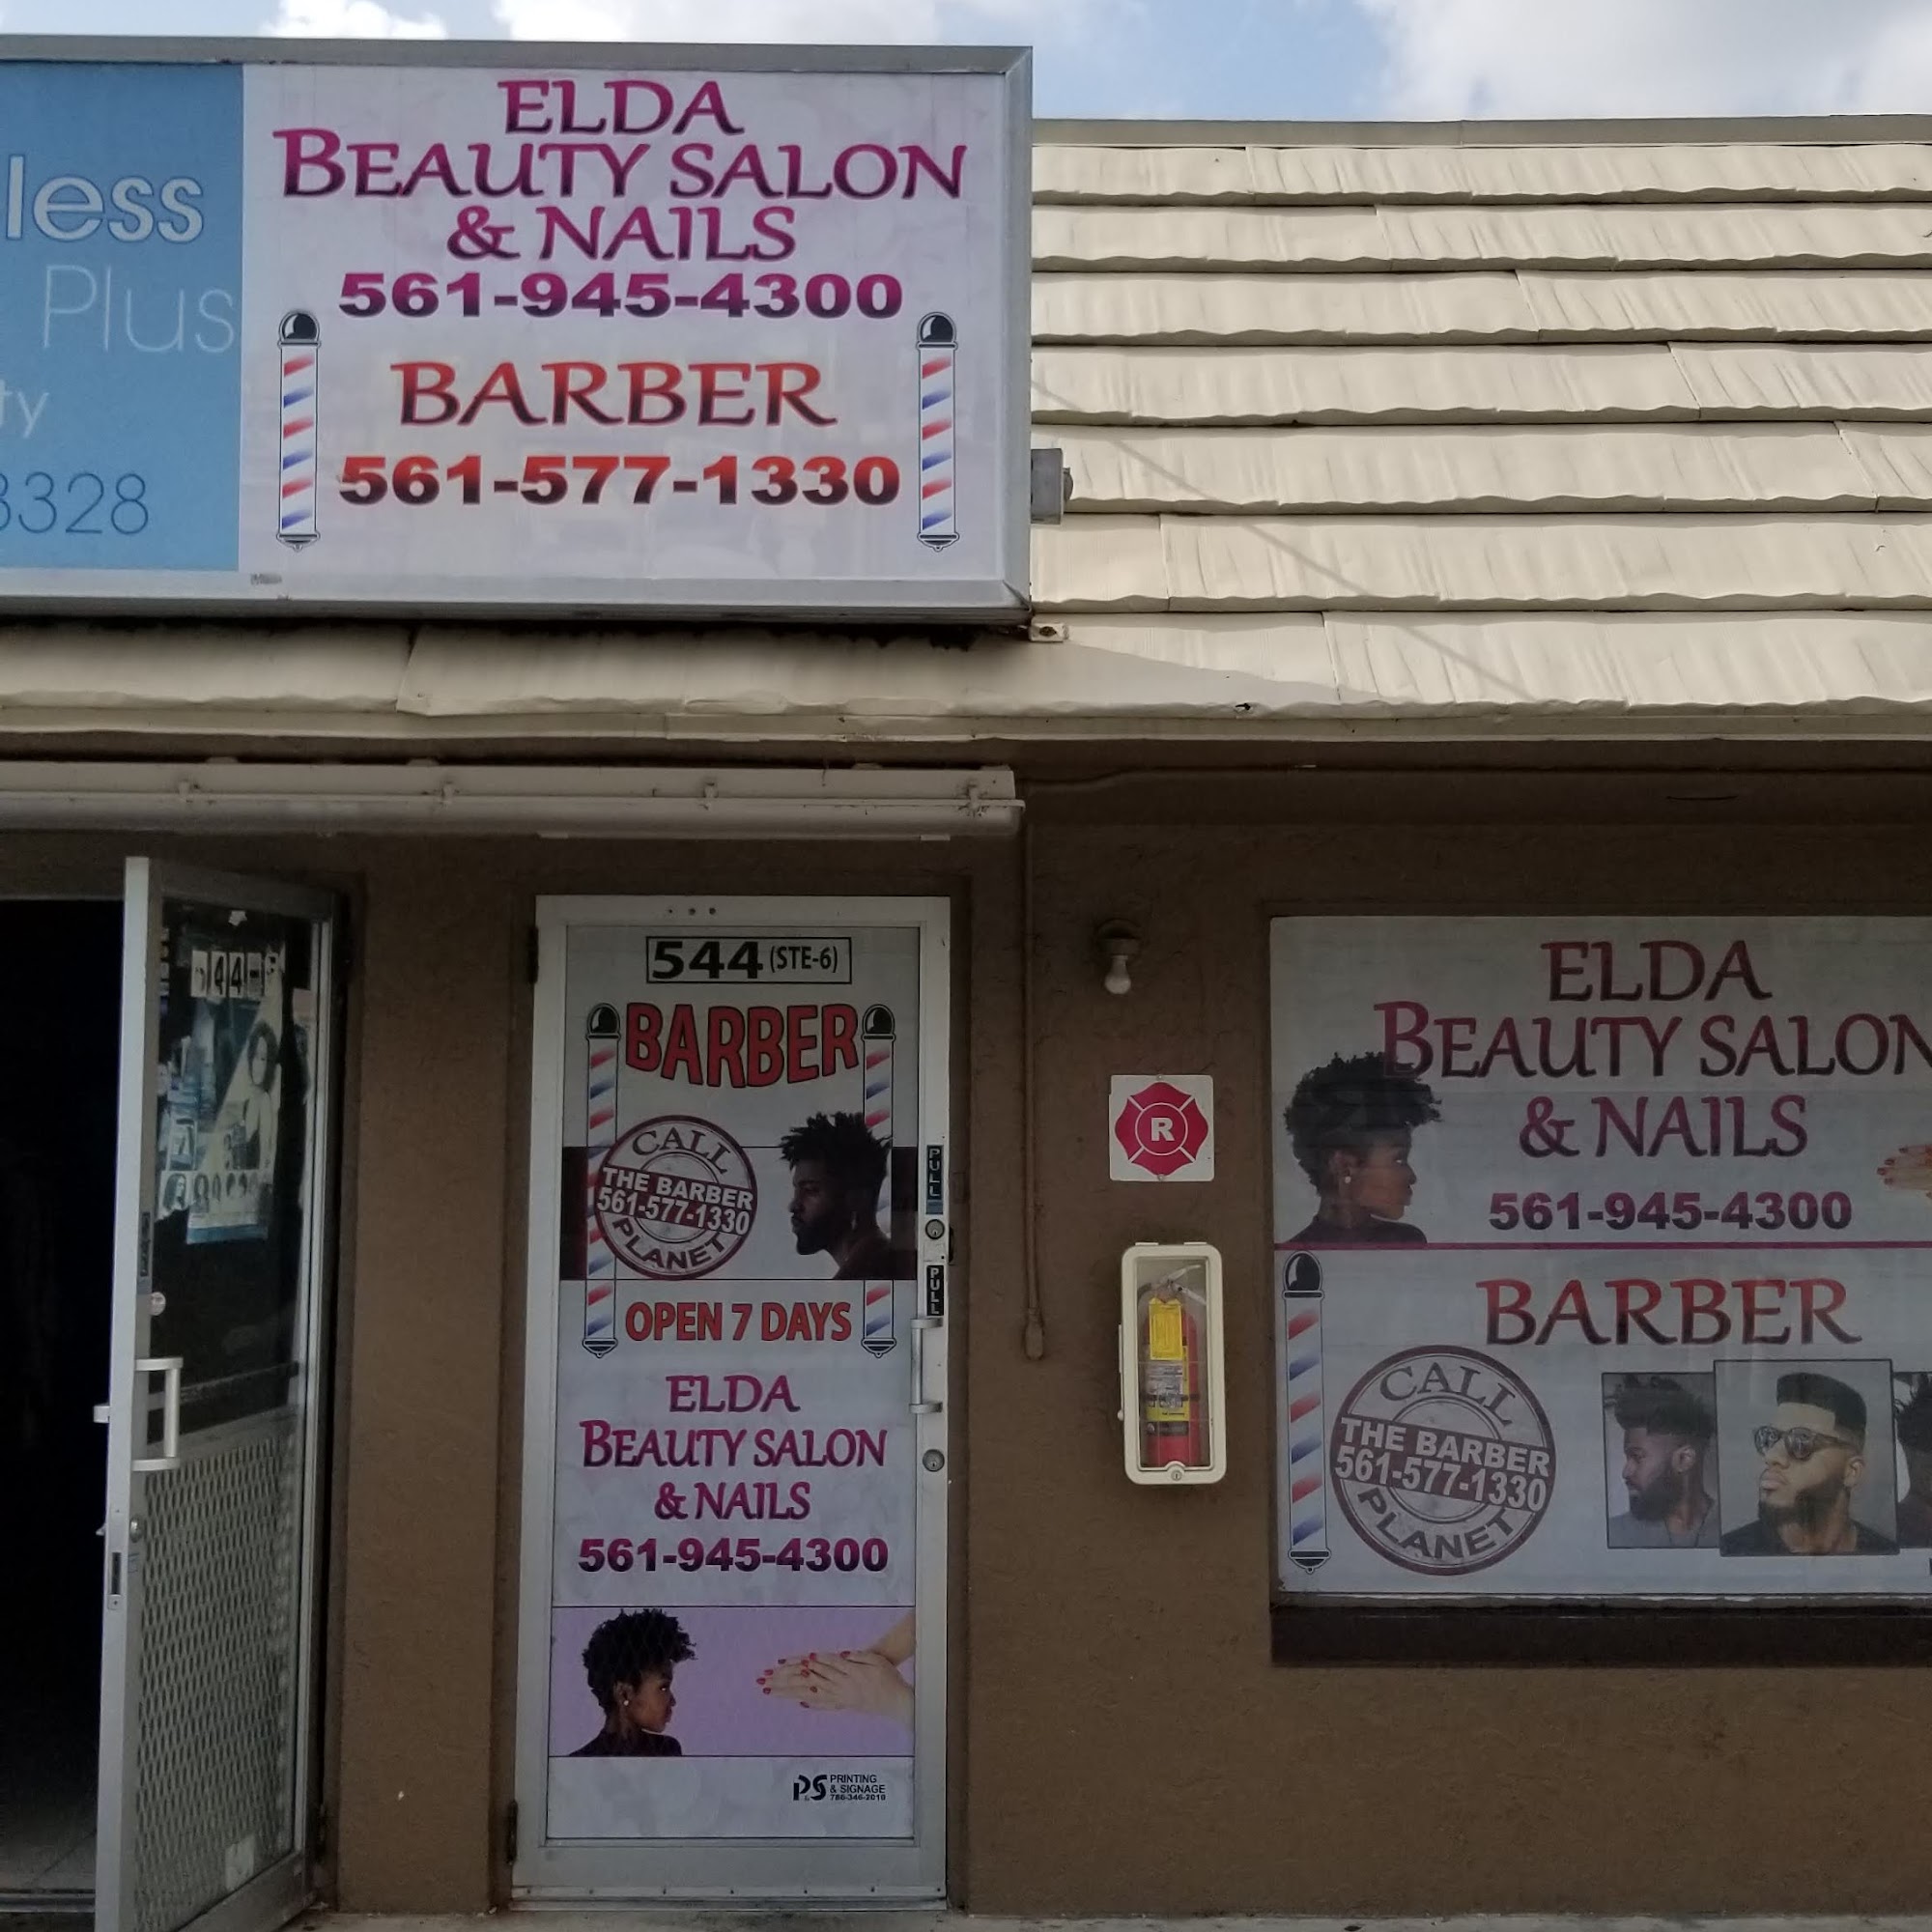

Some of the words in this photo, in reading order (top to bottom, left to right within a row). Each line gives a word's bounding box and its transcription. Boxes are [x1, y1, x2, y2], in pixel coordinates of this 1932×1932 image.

[497, 79, 745, 135] ELDA
[272, 128, 650, 198] BEAUTY
[669, 143, 968, 200] SALON
[446, 205, 521, 260] &
[536, 206, 796, 261] NAILS
[43, 264, 235, 355] Plus
[339, 271, 903, 318] 561-945-4300
[390, 360, 838, 427] BARBER
[339, 455, 900, 505] 561-577-1330
[652, 941, 763, 980] 544
[770, 946, 838, 973] (STE-6)
[1540, 940, 1773, 1001] ELDA
[626, 1002, 860, 1088] BARBER
[1374, 1001, 1682, 1079] BEAUTY
[632, 1126, 730, 1174] CALL
[1150, 1118, 1175, 1141] R
[1519, 1096, 1579, 1157] &
[1591, 1094, 1807, 1157] NAILS
[603, 1167, 650, 1192] THE
[656, 1177, 753, 1210] BARBER
[929, 1148, 941, 1197] PULL
[597, 1187, 750, 1236] 561-577-1330
[1489, 1191, 1852, 1230] 561-945-4300
[612, 1217, 724, 1269] PLANET
[929, 1267, 941, 1315] PULL
[1475, 1278, 1861, 1346] BARBER
[625, 1302, 726, 1341] OPEN
[731, 1302, 752, 1341] 7
[761, 1301, 852, 1341] DAYS
[666, 1375, 800, 1412] ELDA
[1379, 1362, 1516, 1427] CALL
[580, 1420, 747, 1467] BEAUTY
[753, 1429, 887, 1466] SALON
[1341, 1417, 1406, 1452] THE
[1415, 1431, 1550, 1477] BARBER
[654, 1482, 688, 1520] &
[695, 1482, 810, 1520] NAILS
[1335, 1445, 1546, 1512] 561-577-1330
[1357, 1488, 1514, 1559] PLANET
[579, 1538, 888, 1572] 561-945-4300
[830, 1784, 837, 1793] &
[840, 1784, 886, 1793] SIGNAGE
[831, 1775, 877, 1783] PRINTING
